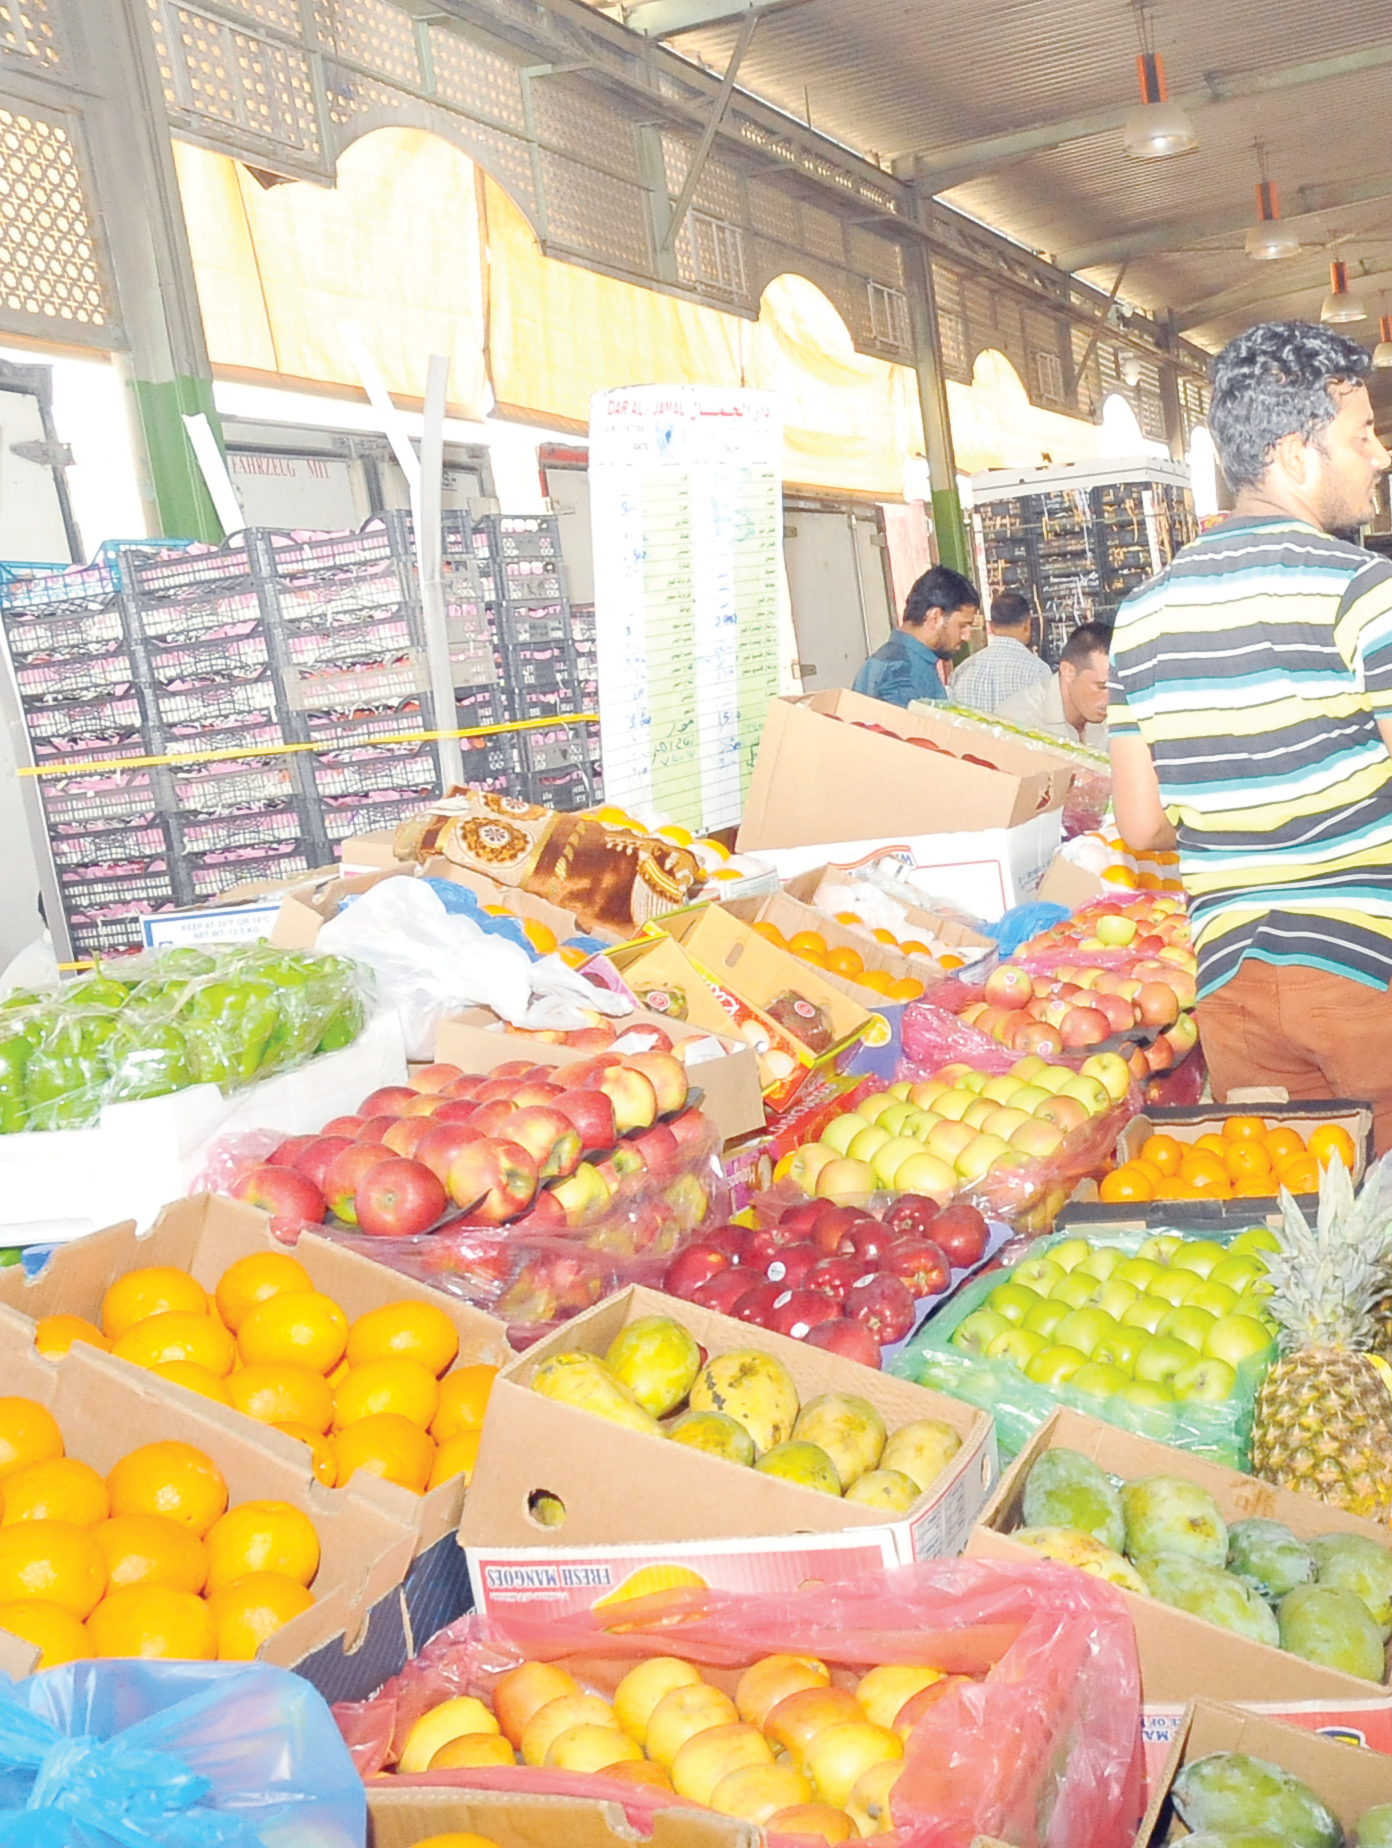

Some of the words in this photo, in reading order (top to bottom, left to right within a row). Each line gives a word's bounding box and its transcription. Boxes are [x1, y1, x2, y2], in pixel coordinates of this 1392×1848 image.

[607, 400, 629, 416] DAR
[653, 401, 685, 417] JAMAL
[231, 455, 297, 478] FAHRZEUG
[305, 459, 331, 480] MIT
[181, 922, 203, 932] KEEP
[205, 921, 216, 930] AT
[193, 931, 210, 940] NET
[487, 1569, 557, 1586] MANGOES
[562, 1568, 610, 1585] FRESH
